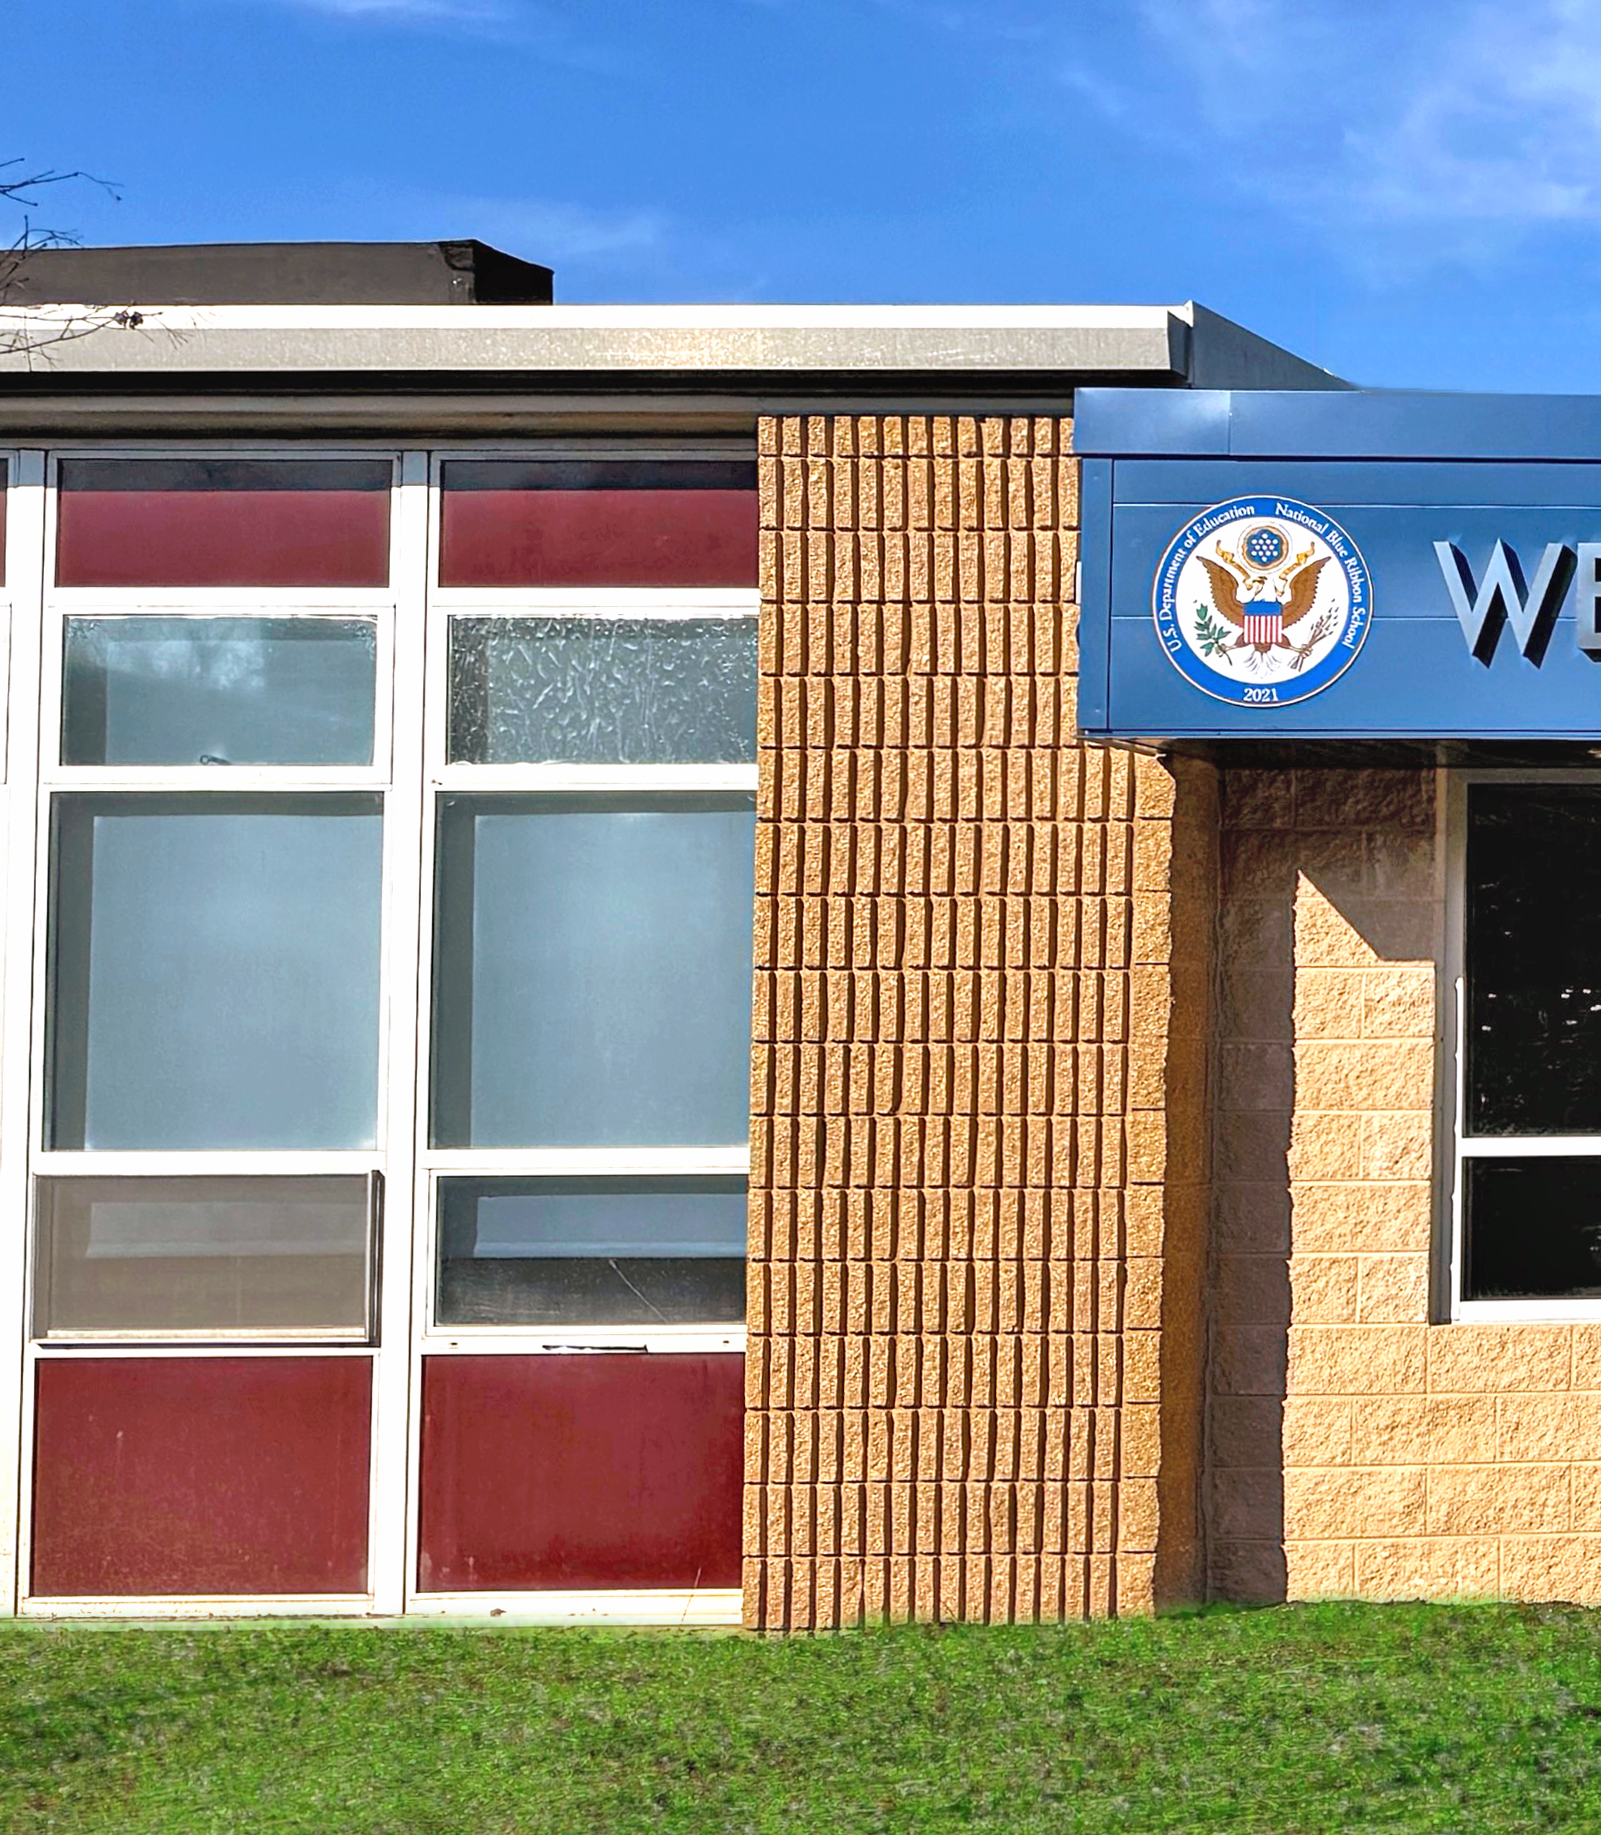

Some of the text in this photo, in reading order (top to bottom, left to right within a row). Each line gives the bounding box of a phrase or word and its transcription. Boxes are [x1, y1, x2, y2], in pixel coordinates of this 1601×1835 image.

[1158, 505, 1256, 653] U.S. Department of Education
[1275, 502, 1367, 650] National Blue Ribbon School
[1243, 688, 1279, 703] 2021
